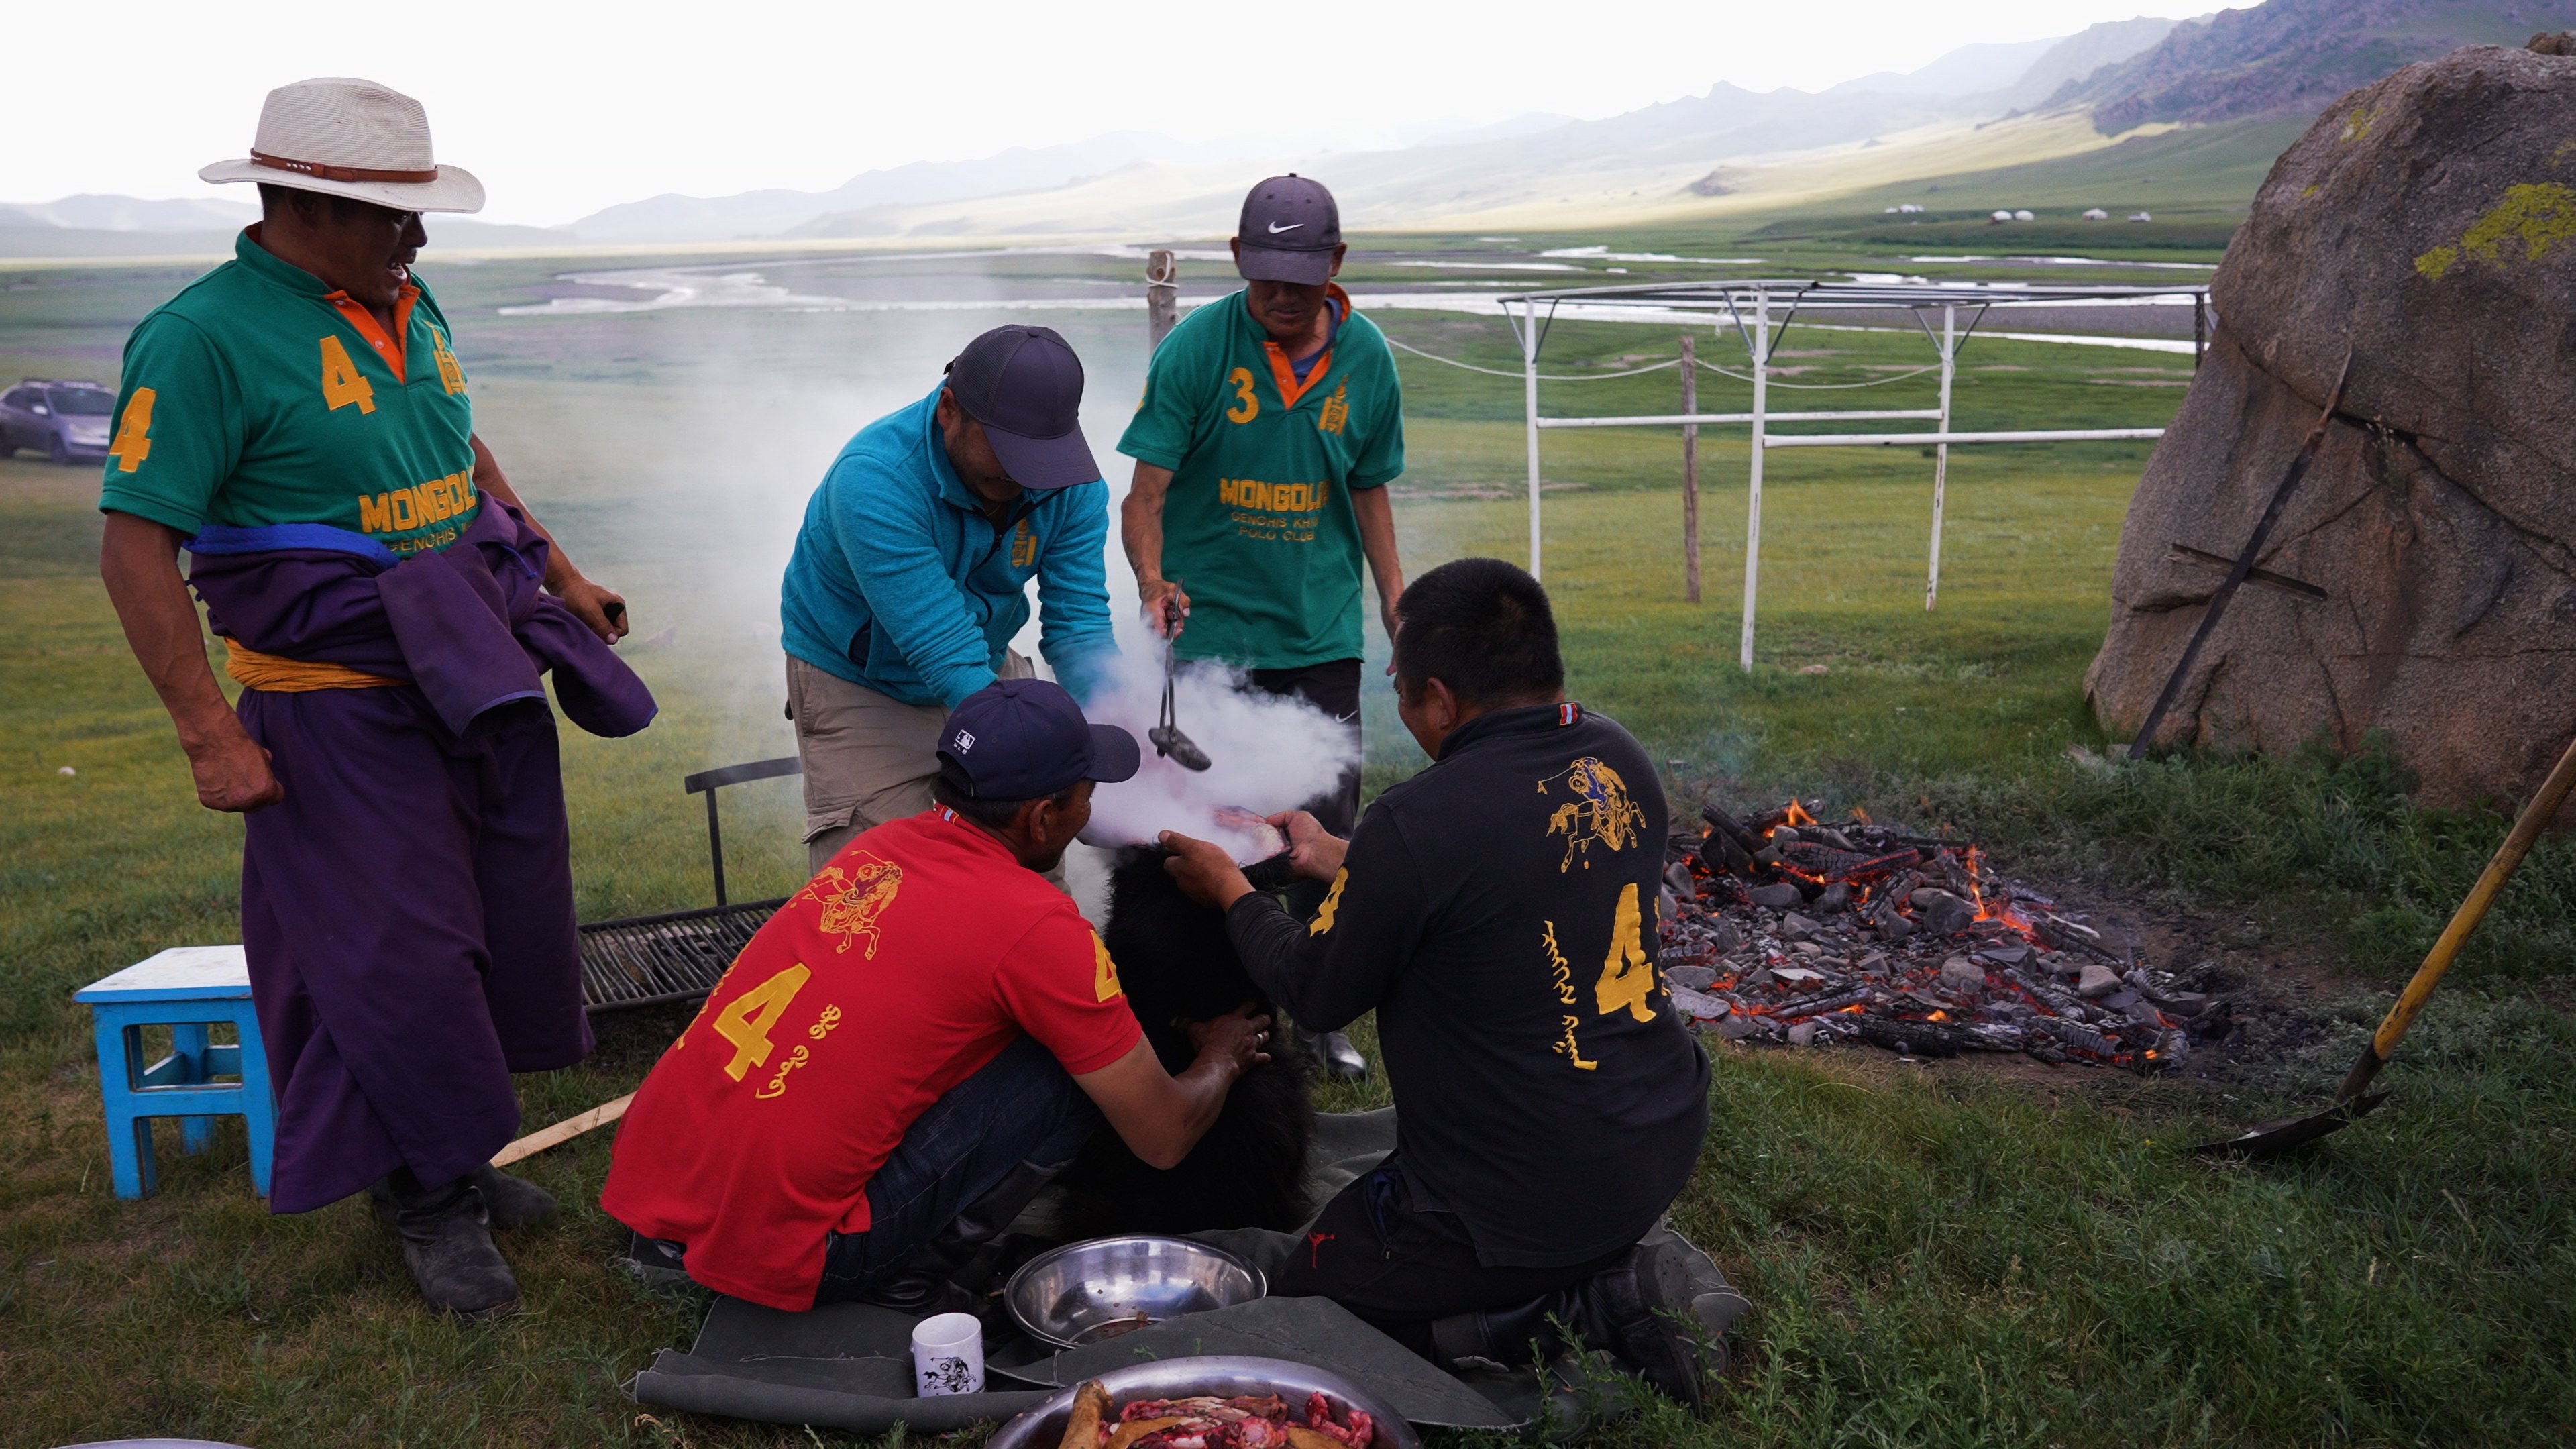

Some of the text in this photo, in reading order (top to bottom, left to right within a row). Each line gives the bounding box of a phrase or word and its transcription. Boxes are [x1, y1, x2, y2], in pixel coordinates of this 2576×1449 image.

[320, 335, 376, 415] 4
[1226, 366, 1260, 424] 3
[109, 386, 157, 473] 4
[1238, 525, 1315, 542] POLO CLUB
[953, 742, 967, 755] MLB
[1595, 883, 1657, 1023] 4
[712, 962, 812, 1082] 4
